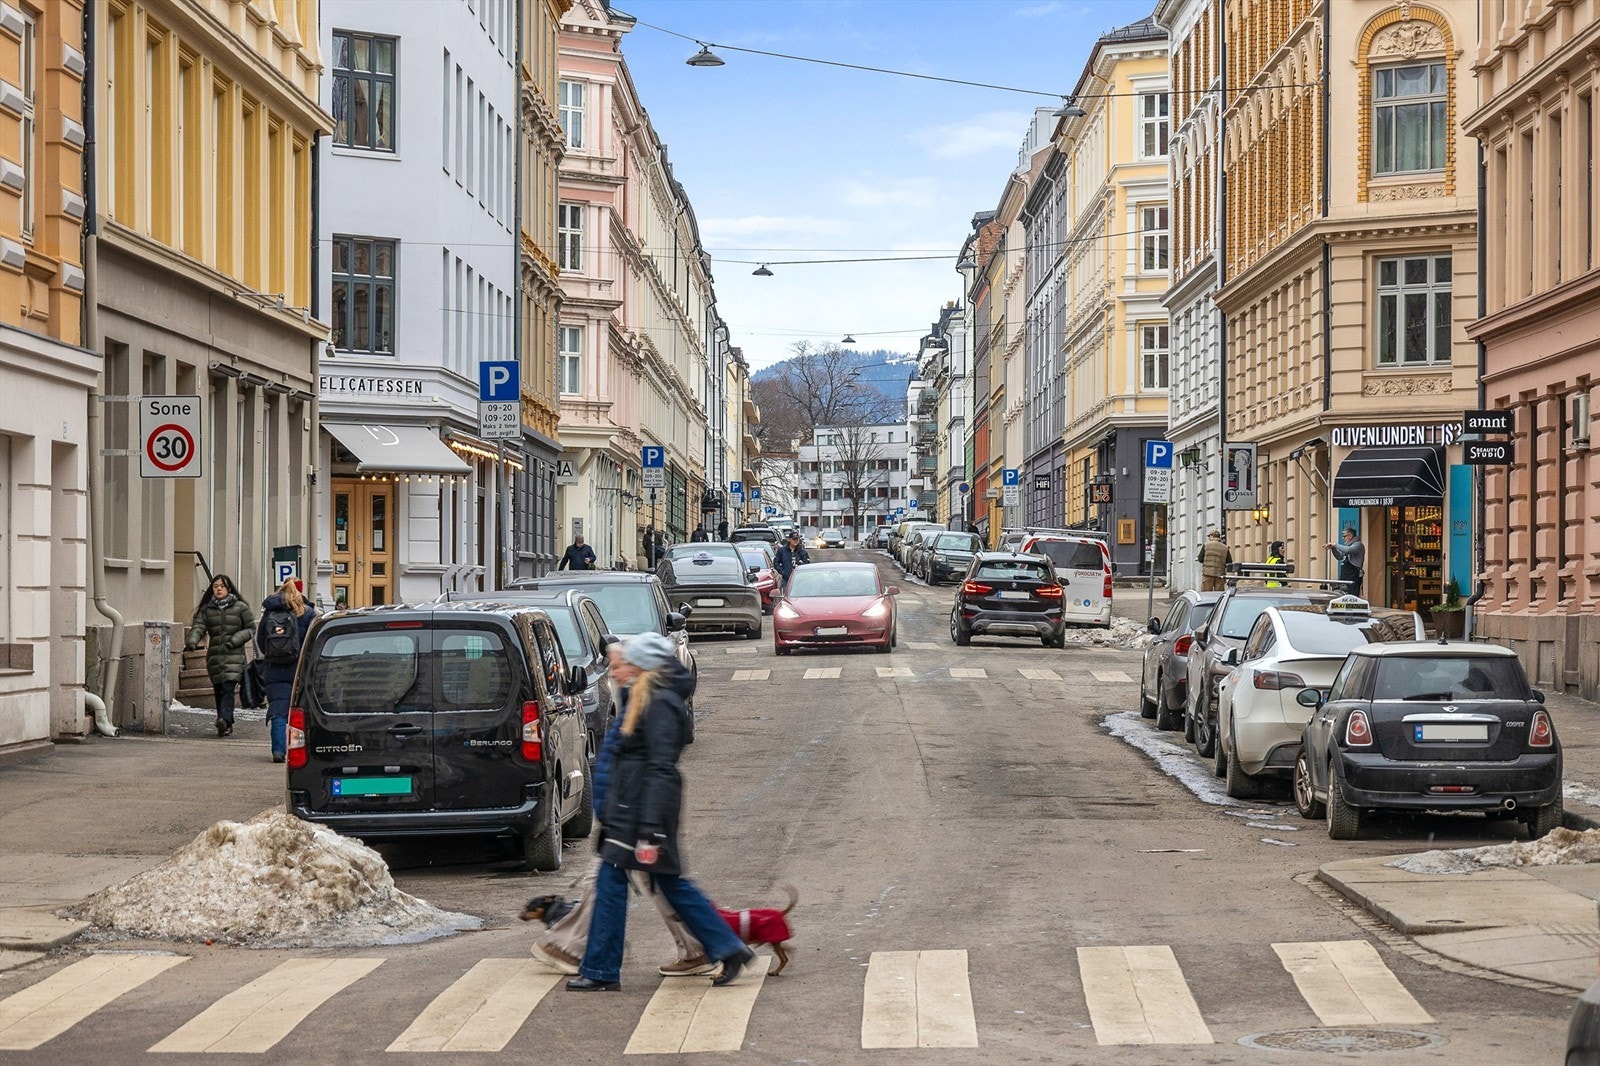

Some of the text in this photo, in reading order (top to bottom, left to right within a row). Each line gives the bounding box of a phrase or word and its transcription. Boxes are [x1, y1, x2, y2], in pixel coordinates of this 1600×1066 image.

[320, 377, 422, 393] ELICATESSEN
[489, 366, 510, 396] P
[150, 401, 191, 415] Sone
[1469, 416, 1506, 428] amnt
[1332, 426, 1425, 446] OLIVENLUNDEN
[156, 436, 186, 459] 30
[1152, 445, 1167, 464] P
[1470, 446, 1505, 458] STUDIO
[648, 449, 659, 465] P
[1006, 472, 1015, 483] P
[732, 483, 739, 491] P
[280, 566, 292, 582] P
[316, 744, 362, 752] CITROËN
